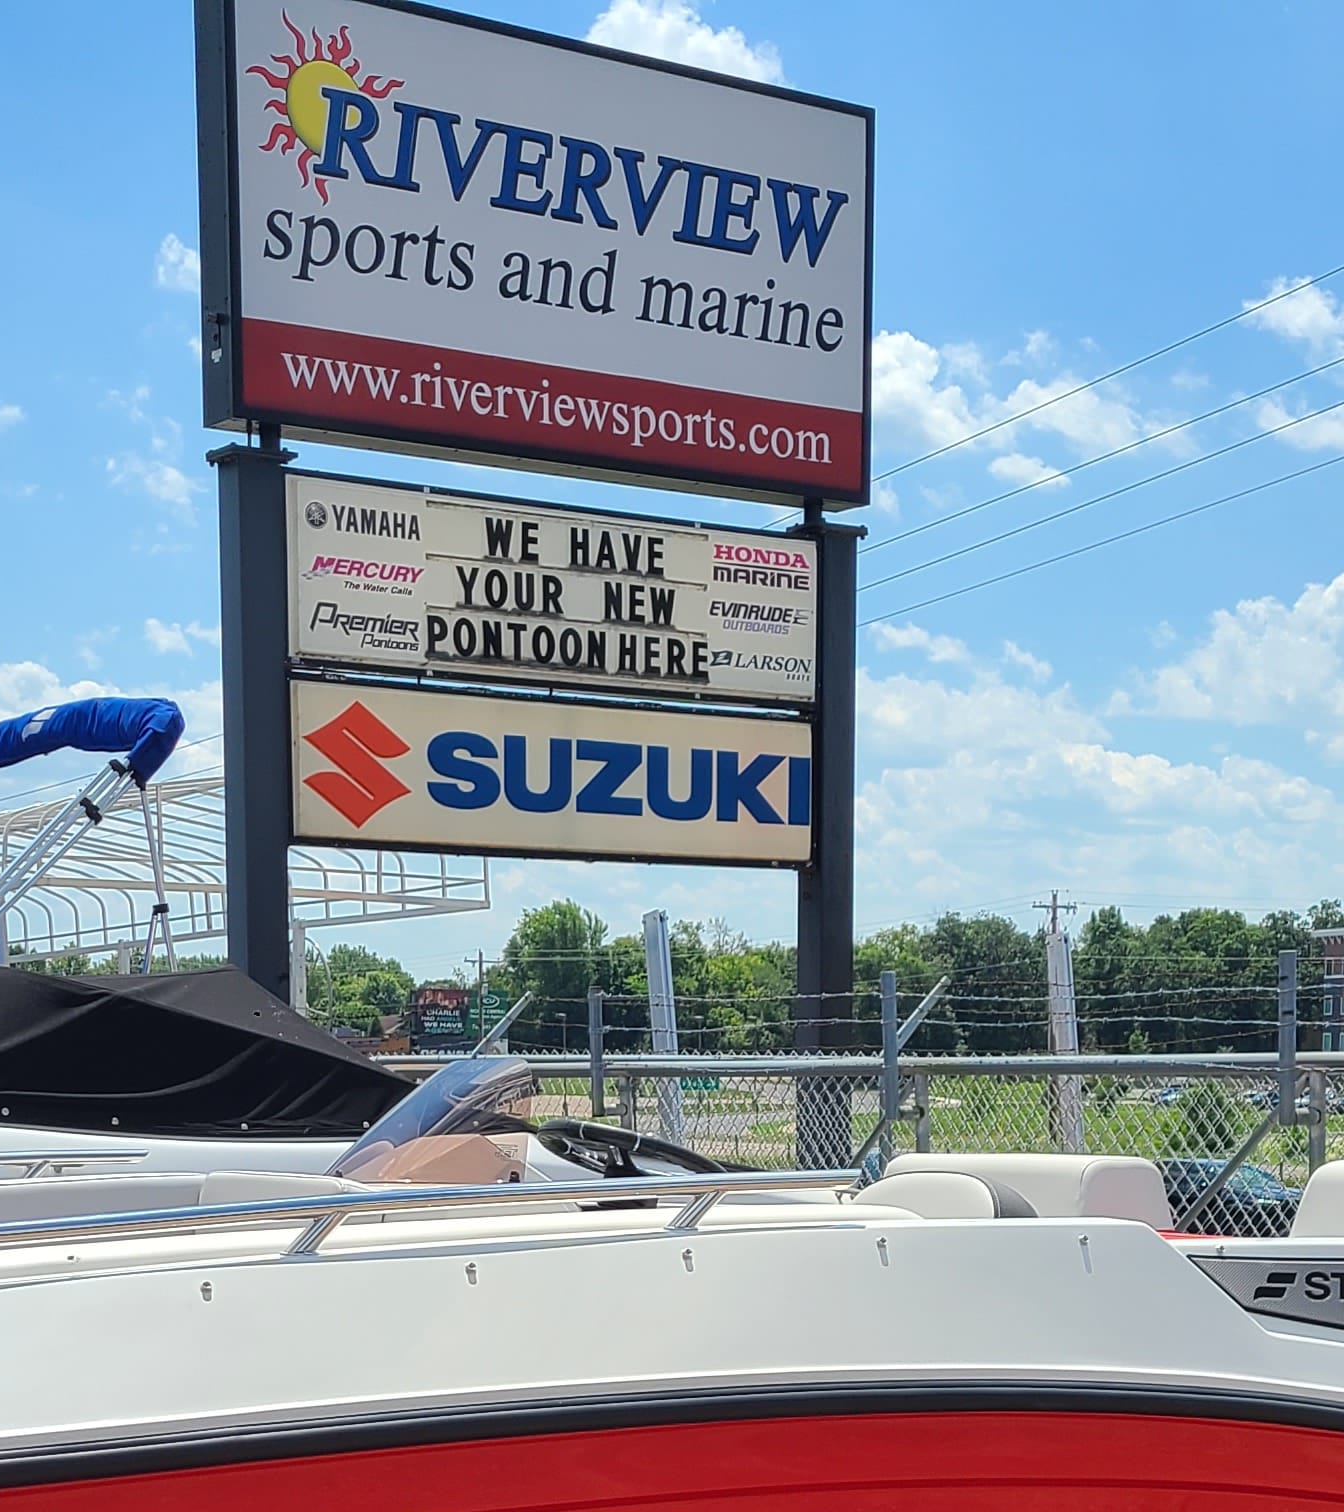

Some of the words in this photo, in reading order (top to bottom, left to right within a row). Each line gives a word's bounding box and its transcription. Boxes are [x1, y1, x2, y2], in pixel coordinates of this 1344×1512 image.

[313, 86, 849, 267] RIVERVIEW
[263, 207, 475, 292] sports
[498, 249, 618, 316] and
[635, 279, 844, 353] marine
[281, 351, 832, 464] www.riverviewsports.com
[331, 504, 421, 541] YAMAHA
[485, 516, 539, 562] WE
[570, 526, 665, 576] HAVE
[713, 543, 810, 569] HONDA
[311, 556, 424, 583] MERCURY
[713, 565, 810, 591] MARINE
[344, 580, 360, 590] The
[363, 582, 389, 593] Water
[391, 586, 413, 596] Calls
[456, 565, 564, 615] YOUR
[604, 581, 676, 626] NEW
[709, 600, 794, 624] EVINRUDE
[722, 619, 791, 635] OUTBOARDS
[361, 633, 419, 652] Pontoons
[427, 614, 606, 667] PONTOON
[618, 632, 709, 679] HERE
[734, 652, 812, 674] LARSON
[425, 730, 811, 826] SUZUKI
